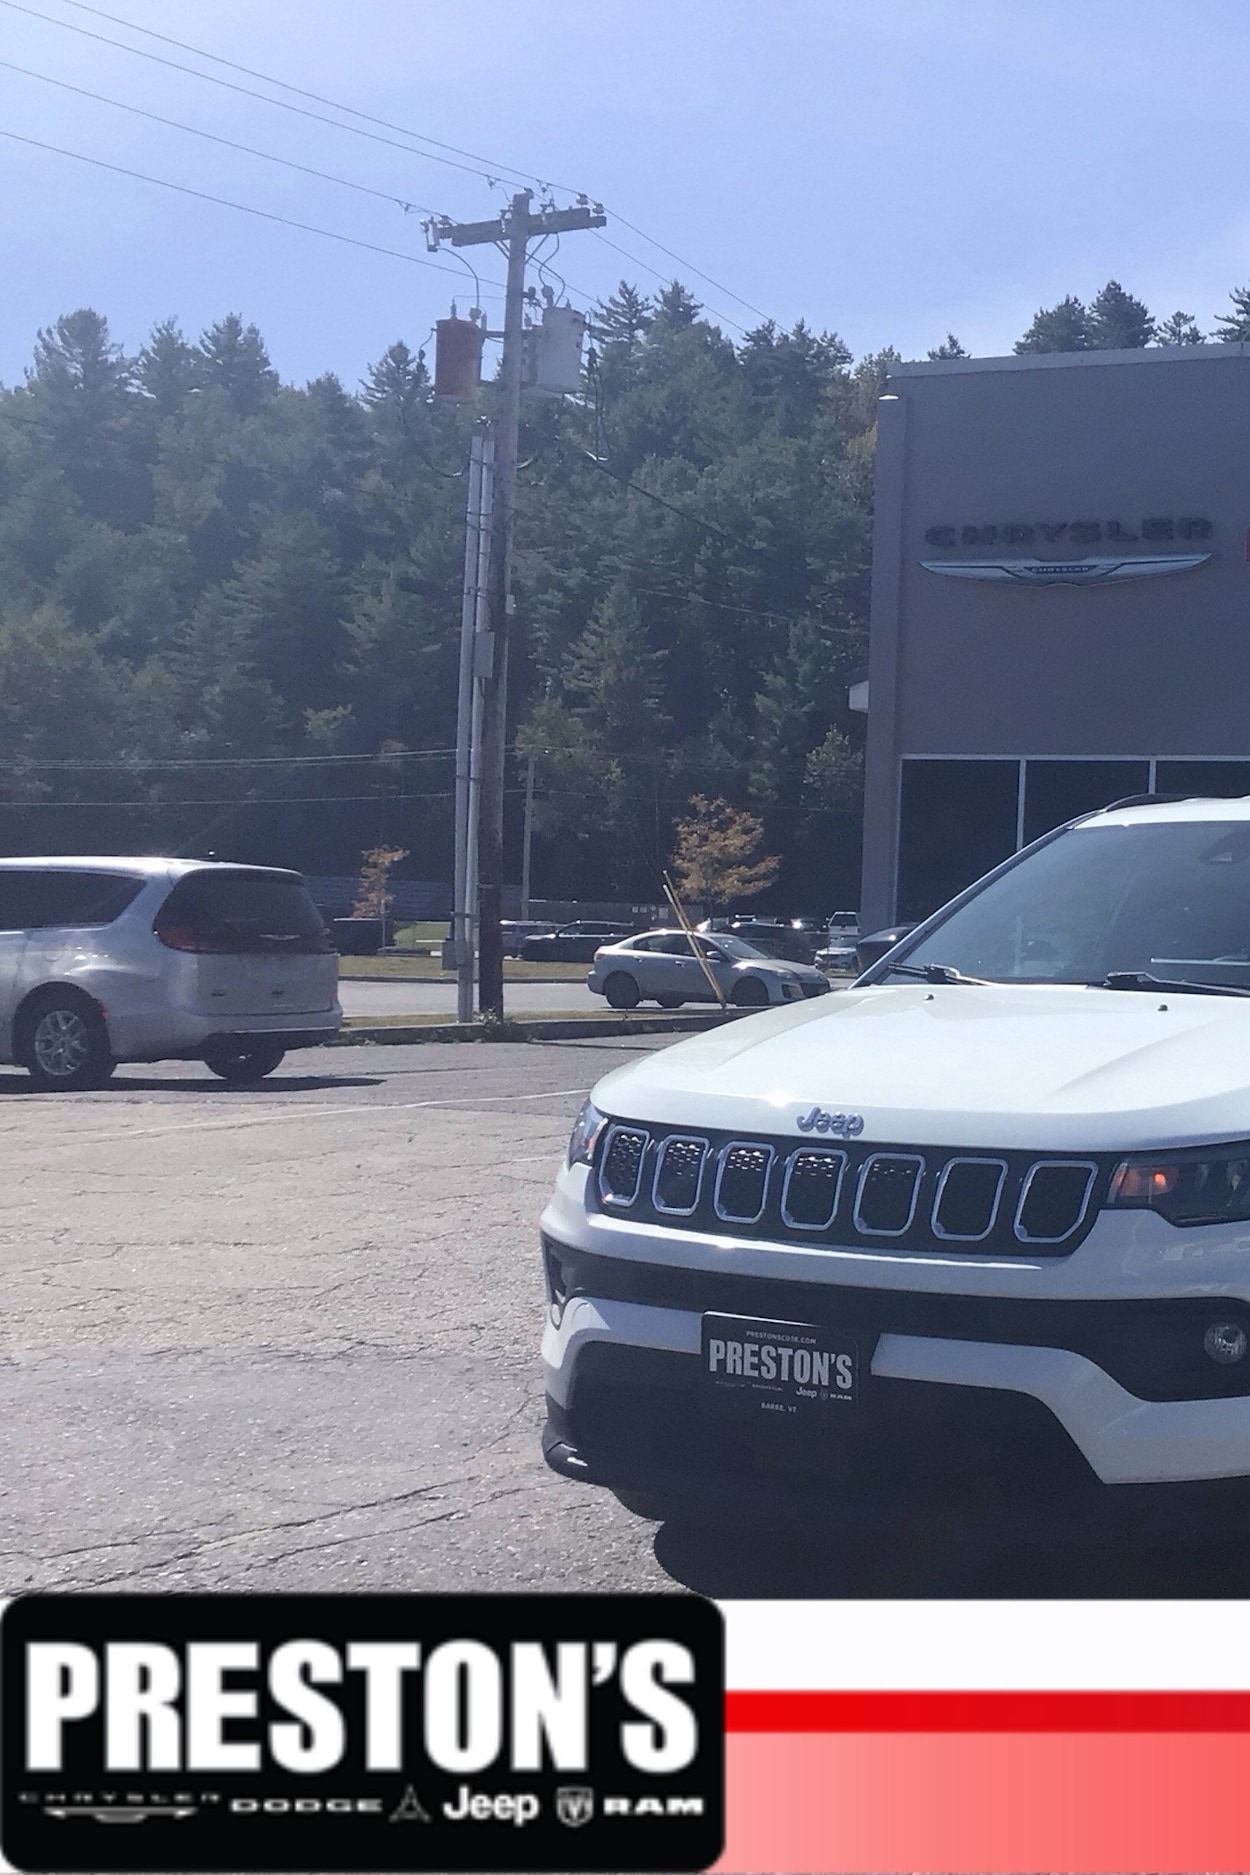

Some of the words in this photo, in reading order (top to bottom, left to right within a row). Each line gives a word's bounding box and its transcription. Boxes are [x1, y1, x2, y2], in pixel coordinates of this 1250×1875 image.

[924, 516, 1214, 548] CHRYSLER
[796, 1107, 865, 1140] Jeep
[709, 1339, 853, 1390] PRESTON'S
[795, 1386, 818, 1399] Jeep
